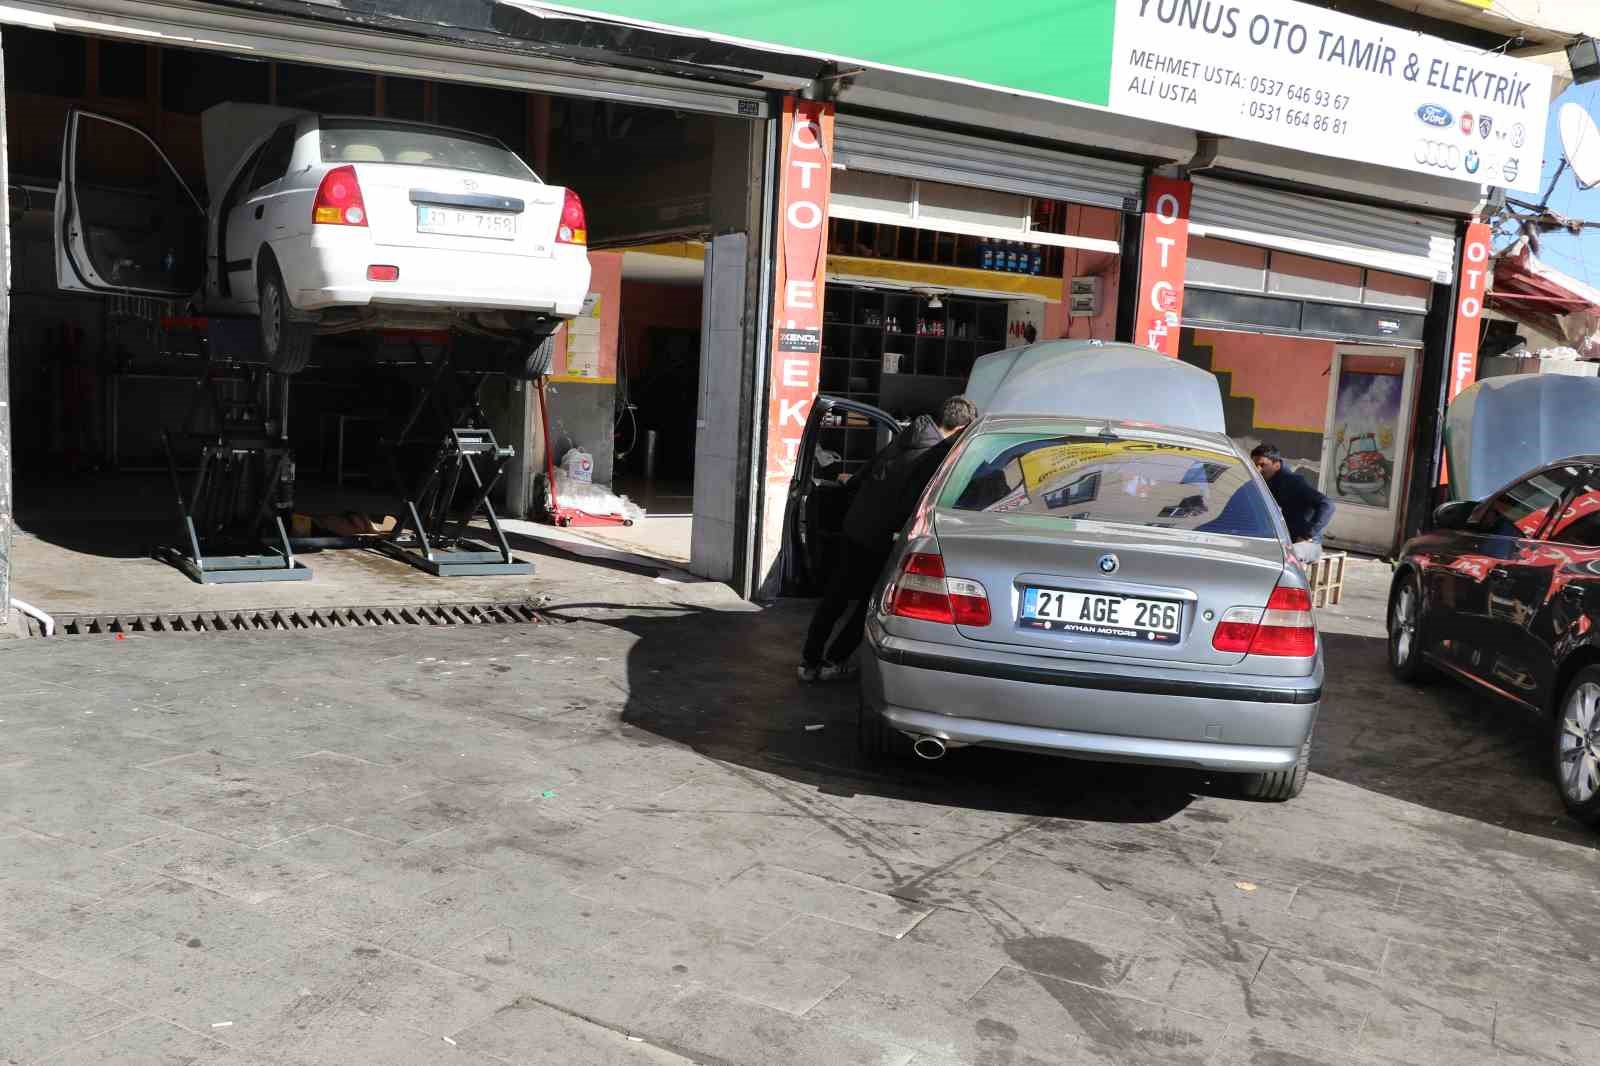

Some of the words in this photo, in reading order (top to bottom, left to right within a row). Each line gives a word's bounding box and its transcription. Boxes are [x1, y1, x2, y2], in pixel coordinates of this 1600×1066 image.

[1129, 48, 1201, 79] MEHMET
[1204, 64, 1247, 89] USTA:
[1250, 75, 1284, 97] 0537
[1287, 84, 1312, 104] 646
[1314, 89, 1330, 107] 93
[1334, 94, 1350, 110] 67
[1249, 14, 1308, 54] OTO
[1317, 30, 1396, 77] TAMİR
[1402, 52, 1420, 82] &
[1427, 58, 1531, 110] ELEKTRİK
[1127, 75, 1156, 97] ALİ
[1159, 81, 1198, 105] USTA
[1249, 101, 1281, 122] 0531
[1286, 108, 1310, 127] 664
[1313, 114, 1329, 132] 86
[1332, 118, 1348, 135] 81
[1461, 242, 1487, 318] OTO
[1038, 592, 1065, 618] 21
[1079, 596, 1121, 624] AGE
[1134, 602, 1176, 630] 266
